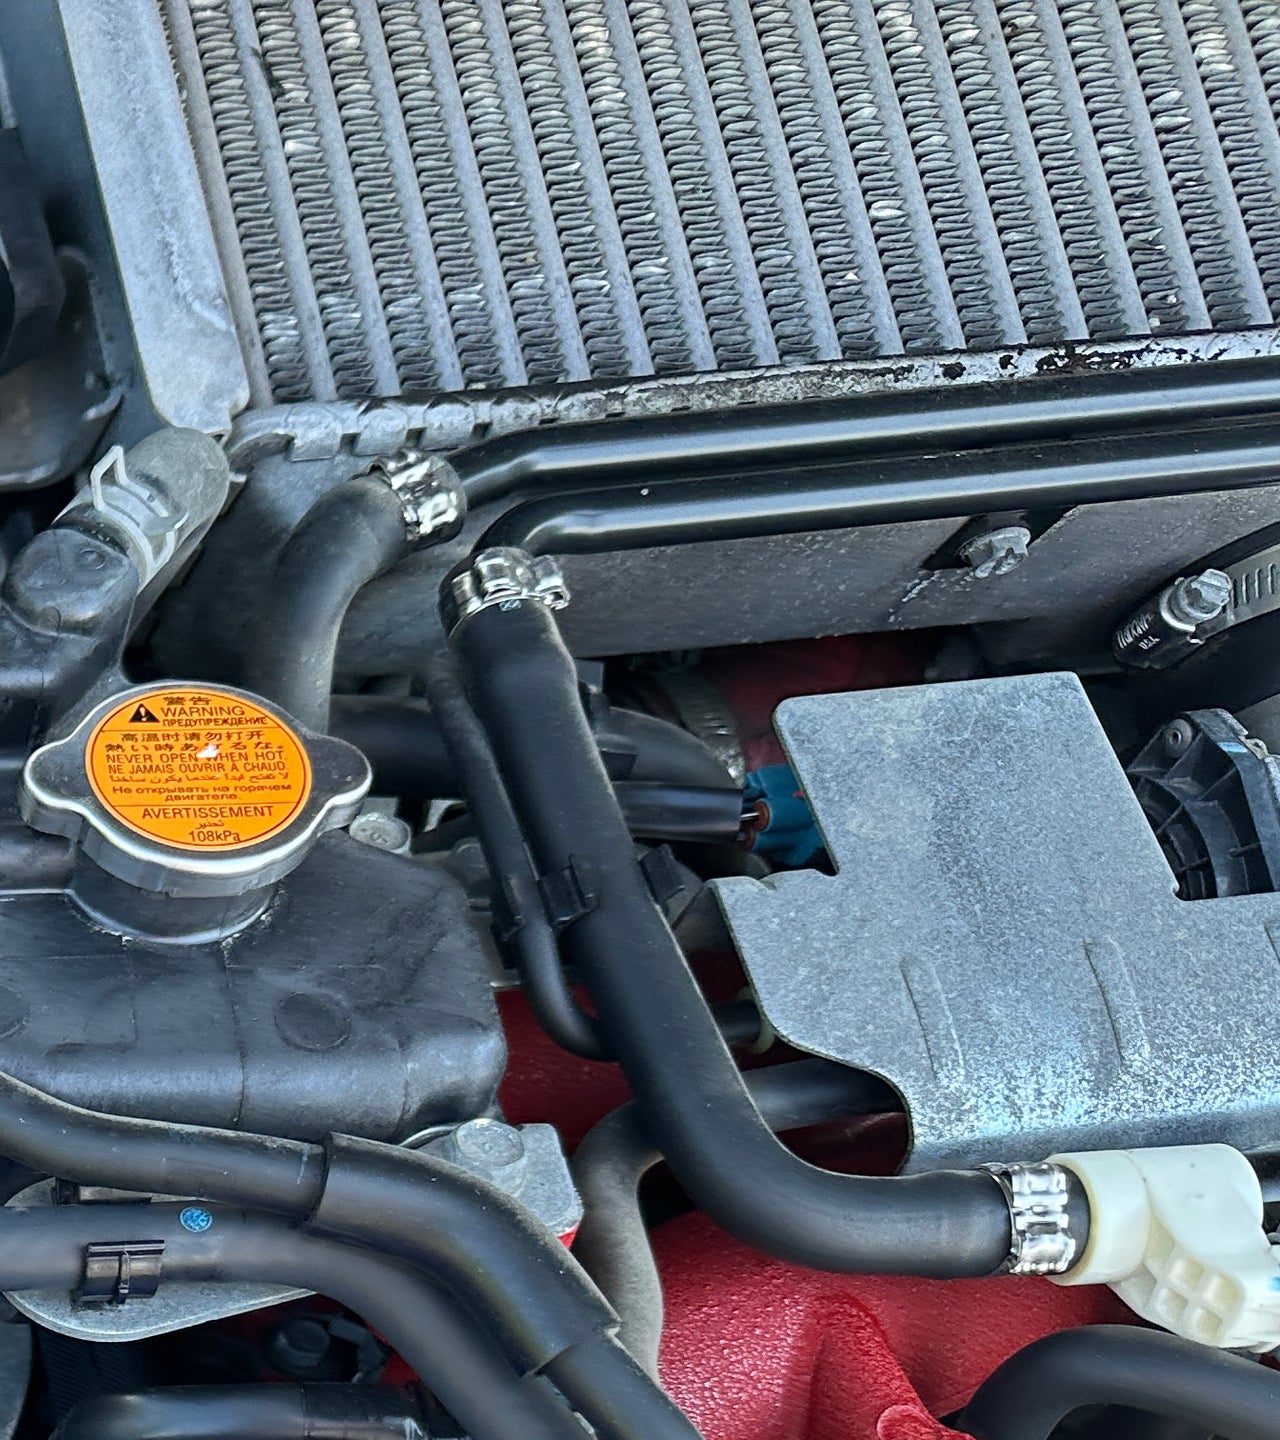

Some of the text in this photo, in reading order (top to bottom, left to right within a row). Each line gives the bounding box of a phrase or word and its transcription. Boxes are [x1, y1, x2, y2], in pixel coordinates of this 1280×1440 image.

[160, 705, 246, 718] WARNING
[162, 716, 268, 728] ПРЕДУПРЕЖДЕНИЕ
[106, 753, 153, 764] NEVER
[160, 752, 198, 763] OPEN
[205, 751, 249, 762] WHEN
[108, 764, 124, 774] NE
[129, 763, 175, 775] JAMAIS
[178, 762, 226, 774] OUVRIR
[112, 783, 292, 795] Не открывать на горячем
[141, 805, 275, 819] AVERTISSEMENT
[187, 830, 241, 843] 108kPa
